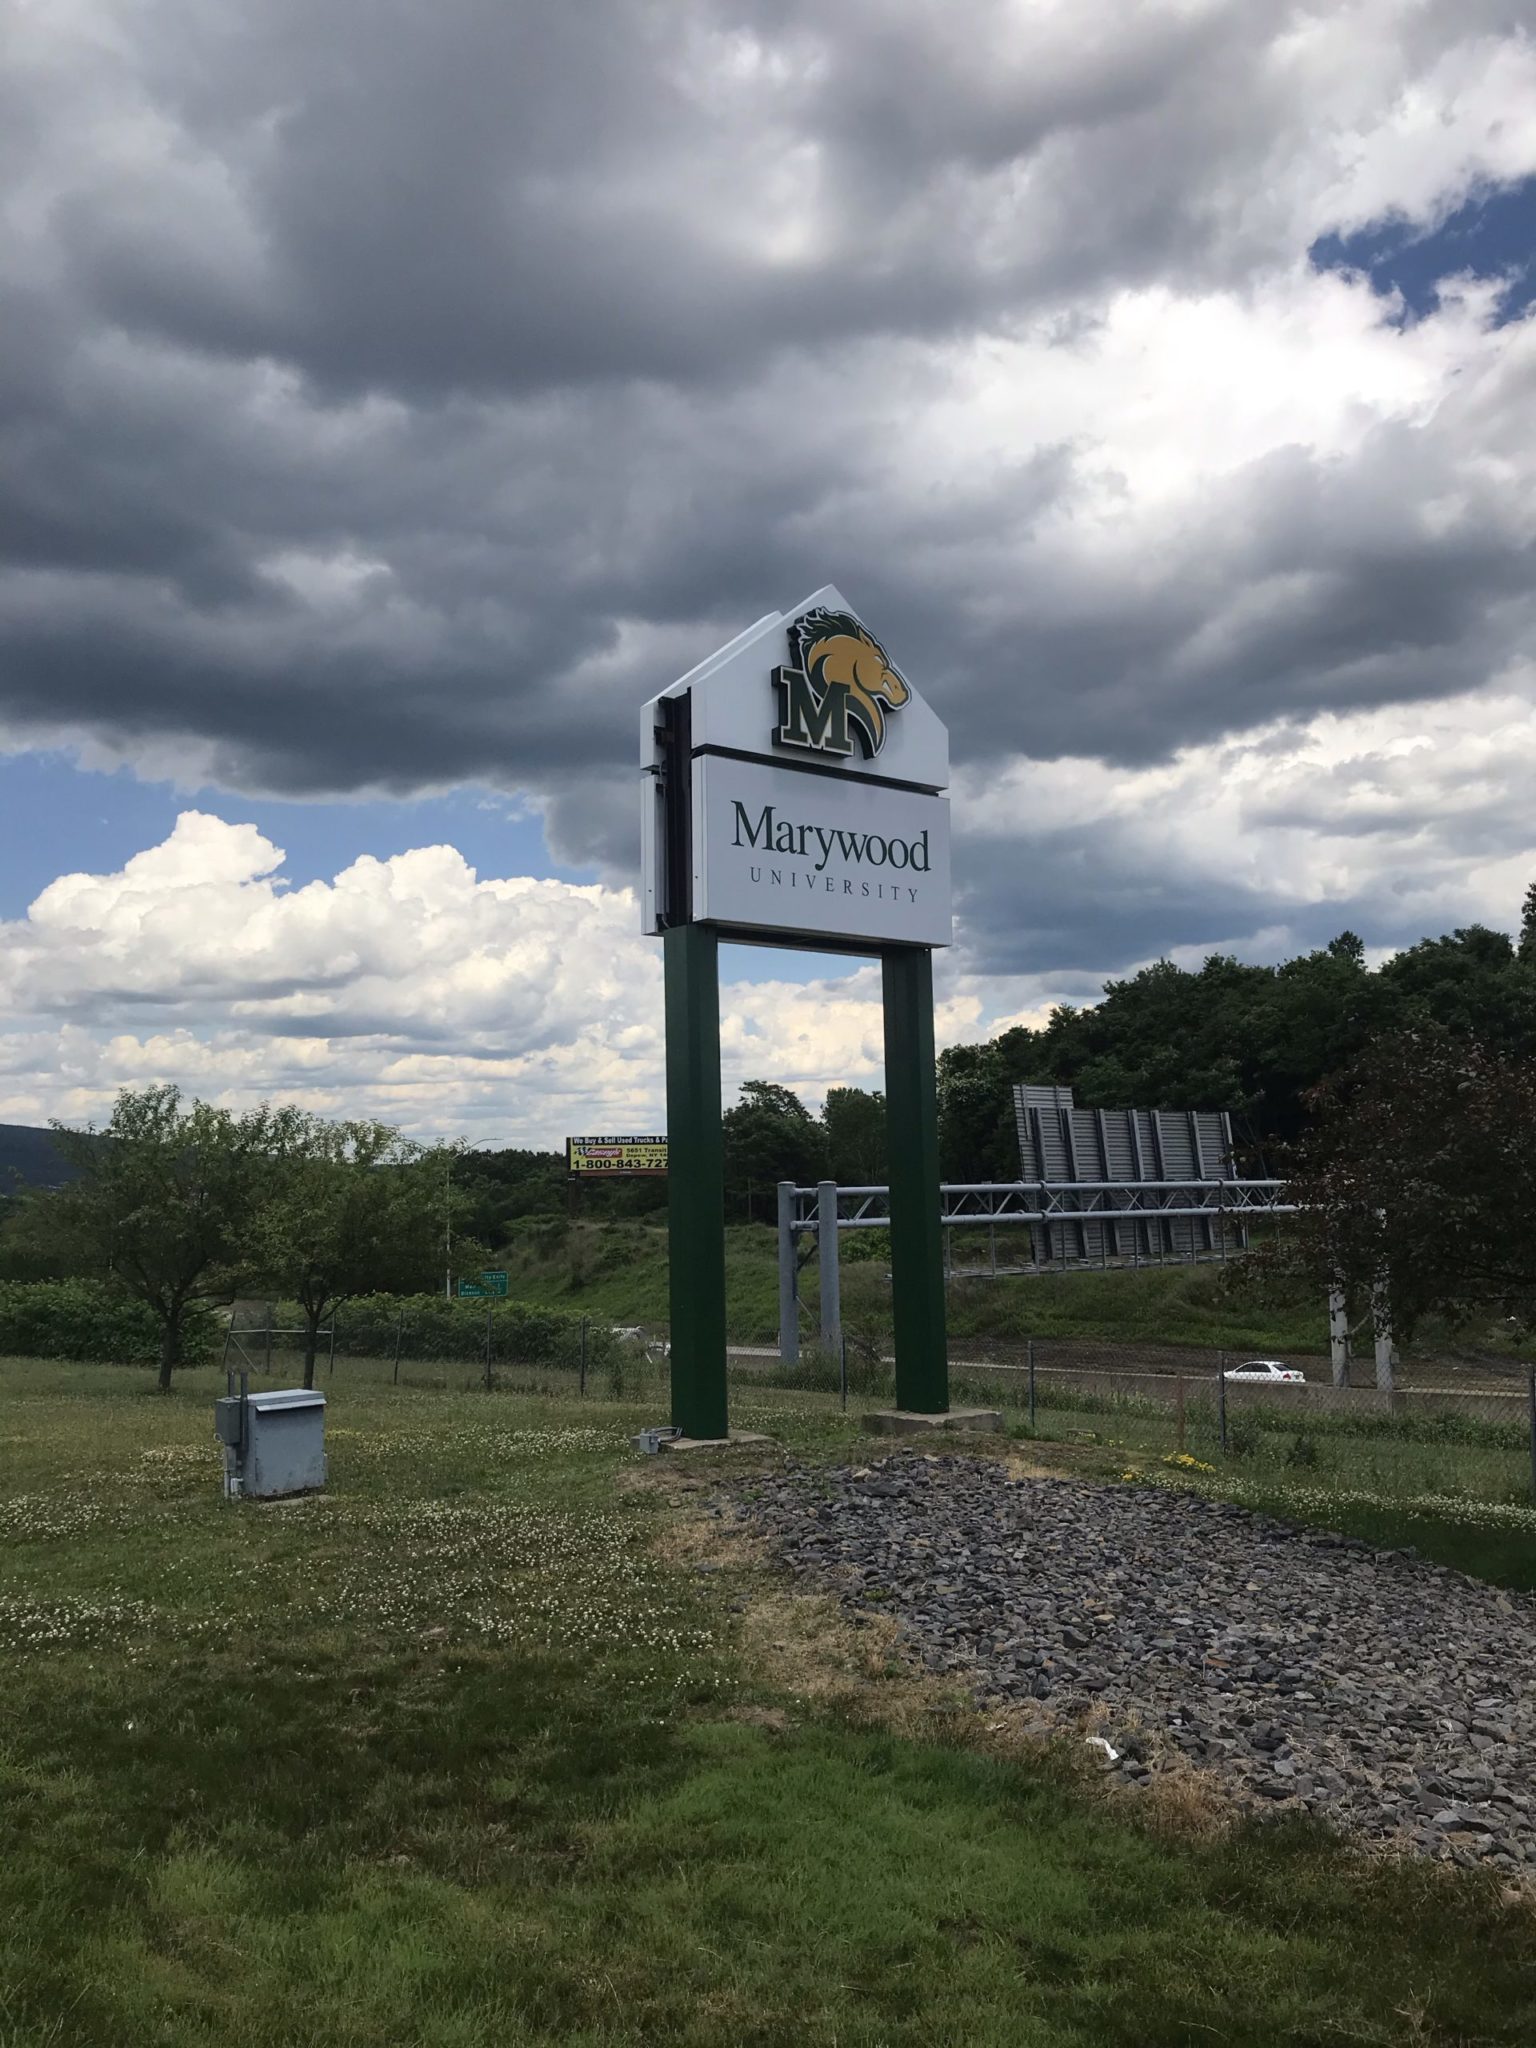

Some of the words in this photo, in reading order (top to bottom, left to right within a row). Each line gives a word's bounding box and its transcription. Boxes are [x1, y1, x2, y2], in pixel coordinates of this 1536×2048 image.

[730, 800, 932, 872] Marywood
[750, 866, 919, 903] UNIVERSITY
[585, 1137, 596, 1145] Buy
[573, 1158, 668, 1169] 1-800-843-727
